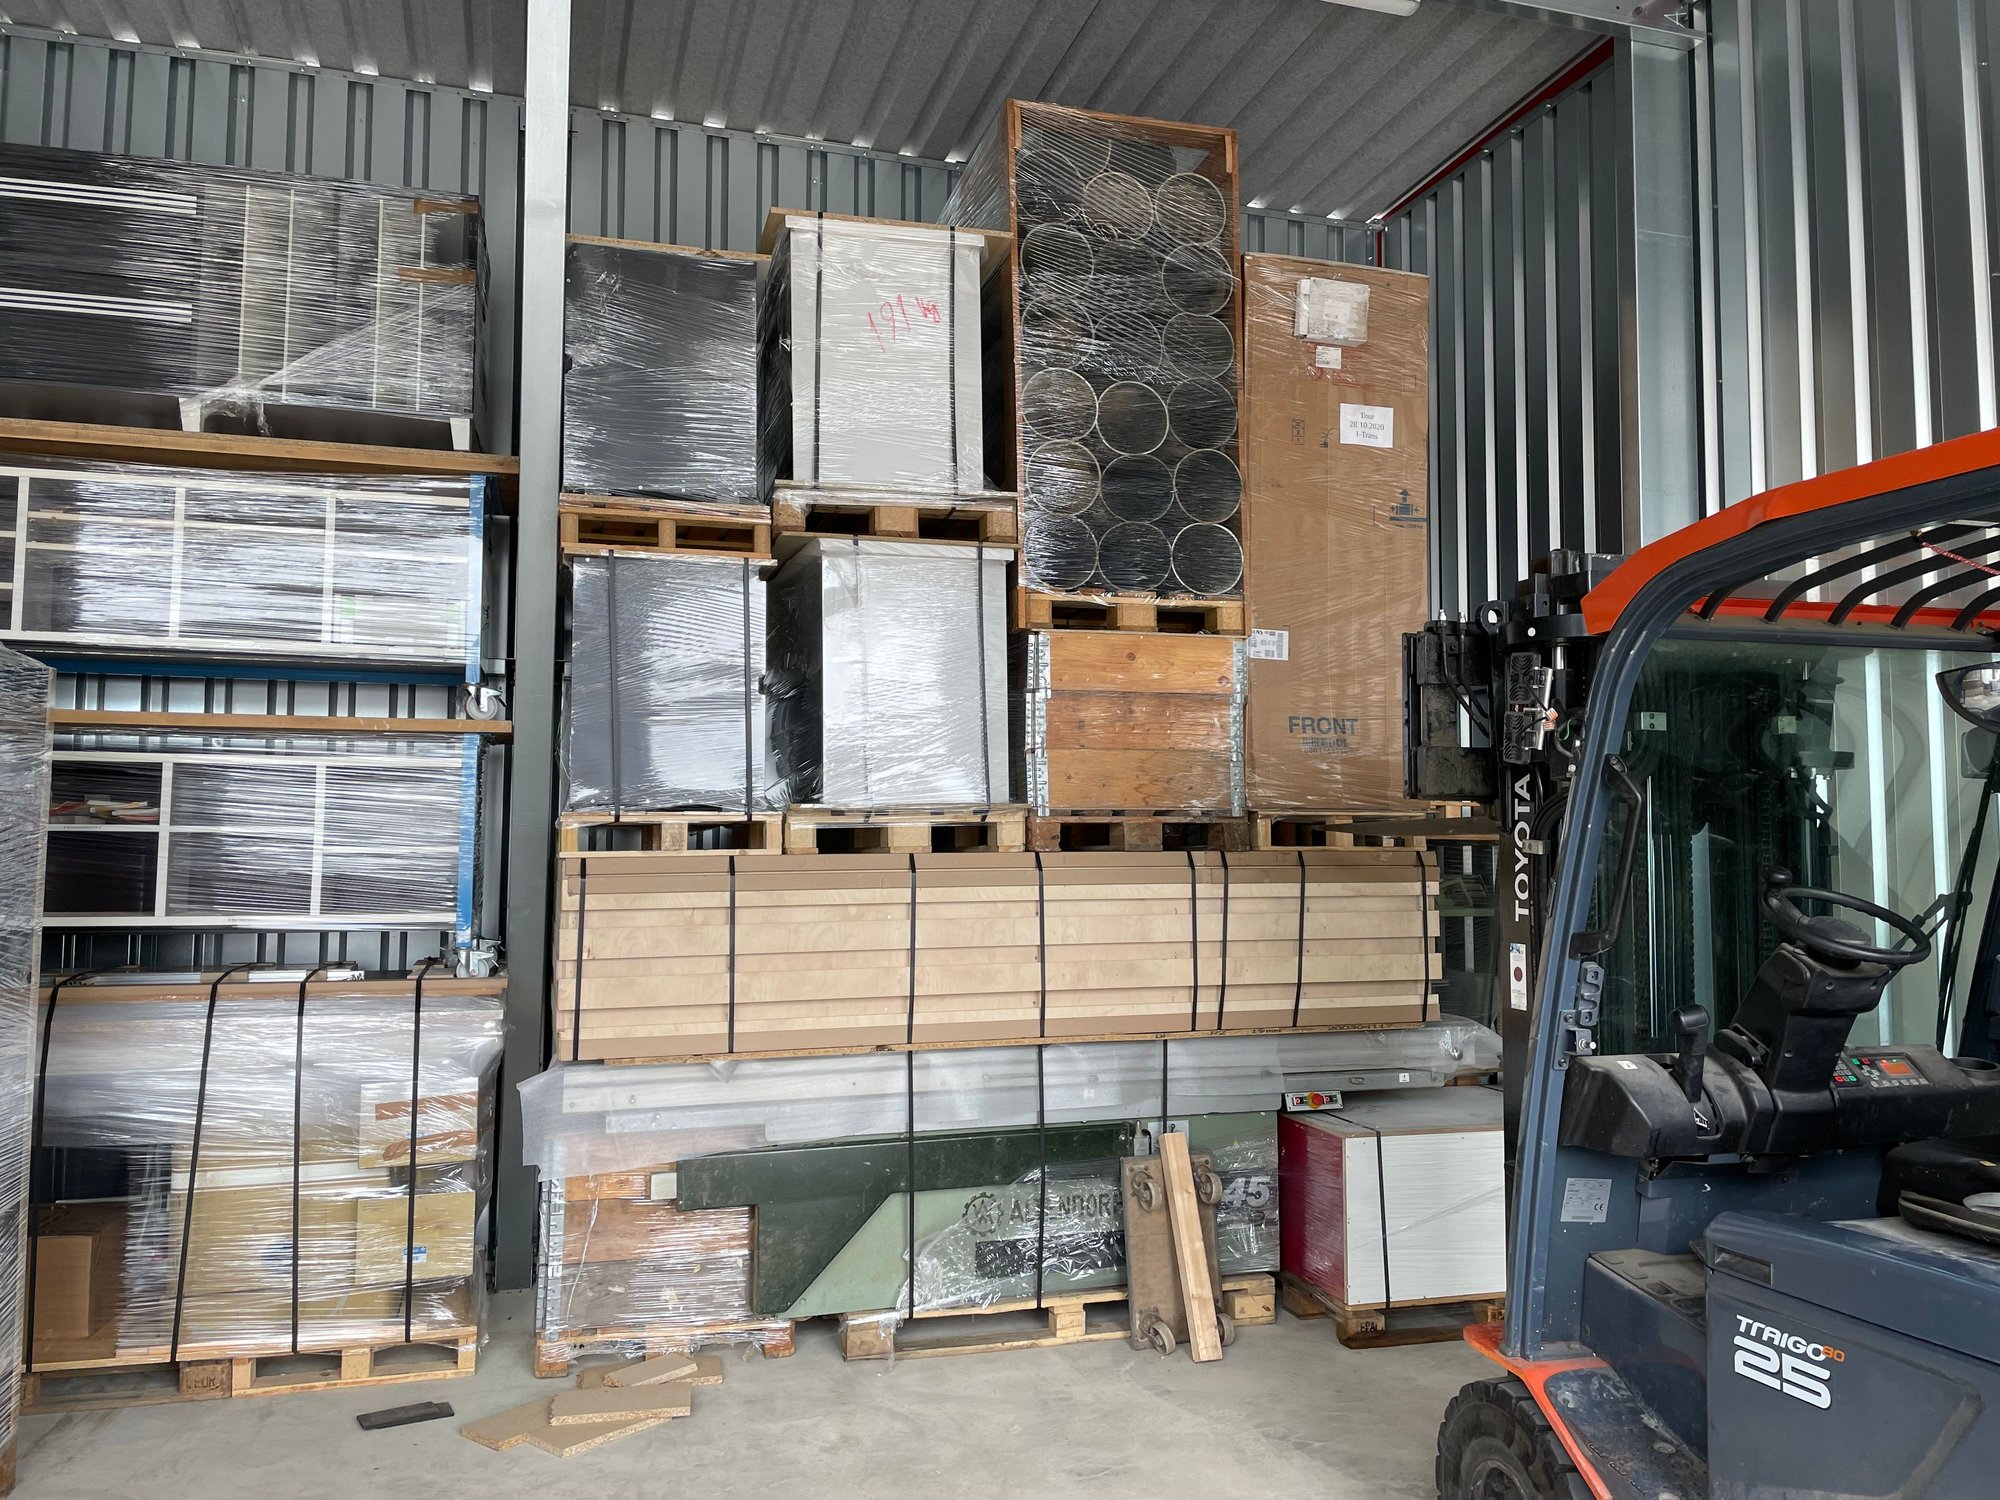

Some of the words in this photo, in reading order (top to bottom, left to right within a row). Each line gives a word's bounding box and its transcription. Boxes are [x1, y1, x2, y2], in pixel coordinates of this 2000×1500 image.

[868, 294, 911, 353] 191
[1349, 421, 1385, 431] 28.10.2020
[1360, 412, 1375, 420] Tour
[1288, 716, 1358, 736] FRONT
[1514, 773, 1530, 922] TOYOTA
[1221, 1175, 1271, 1208] 45
[1736, 1314, 1826, 1361] TRAIGO
[1734, 1335, 1831, 1409] 25
